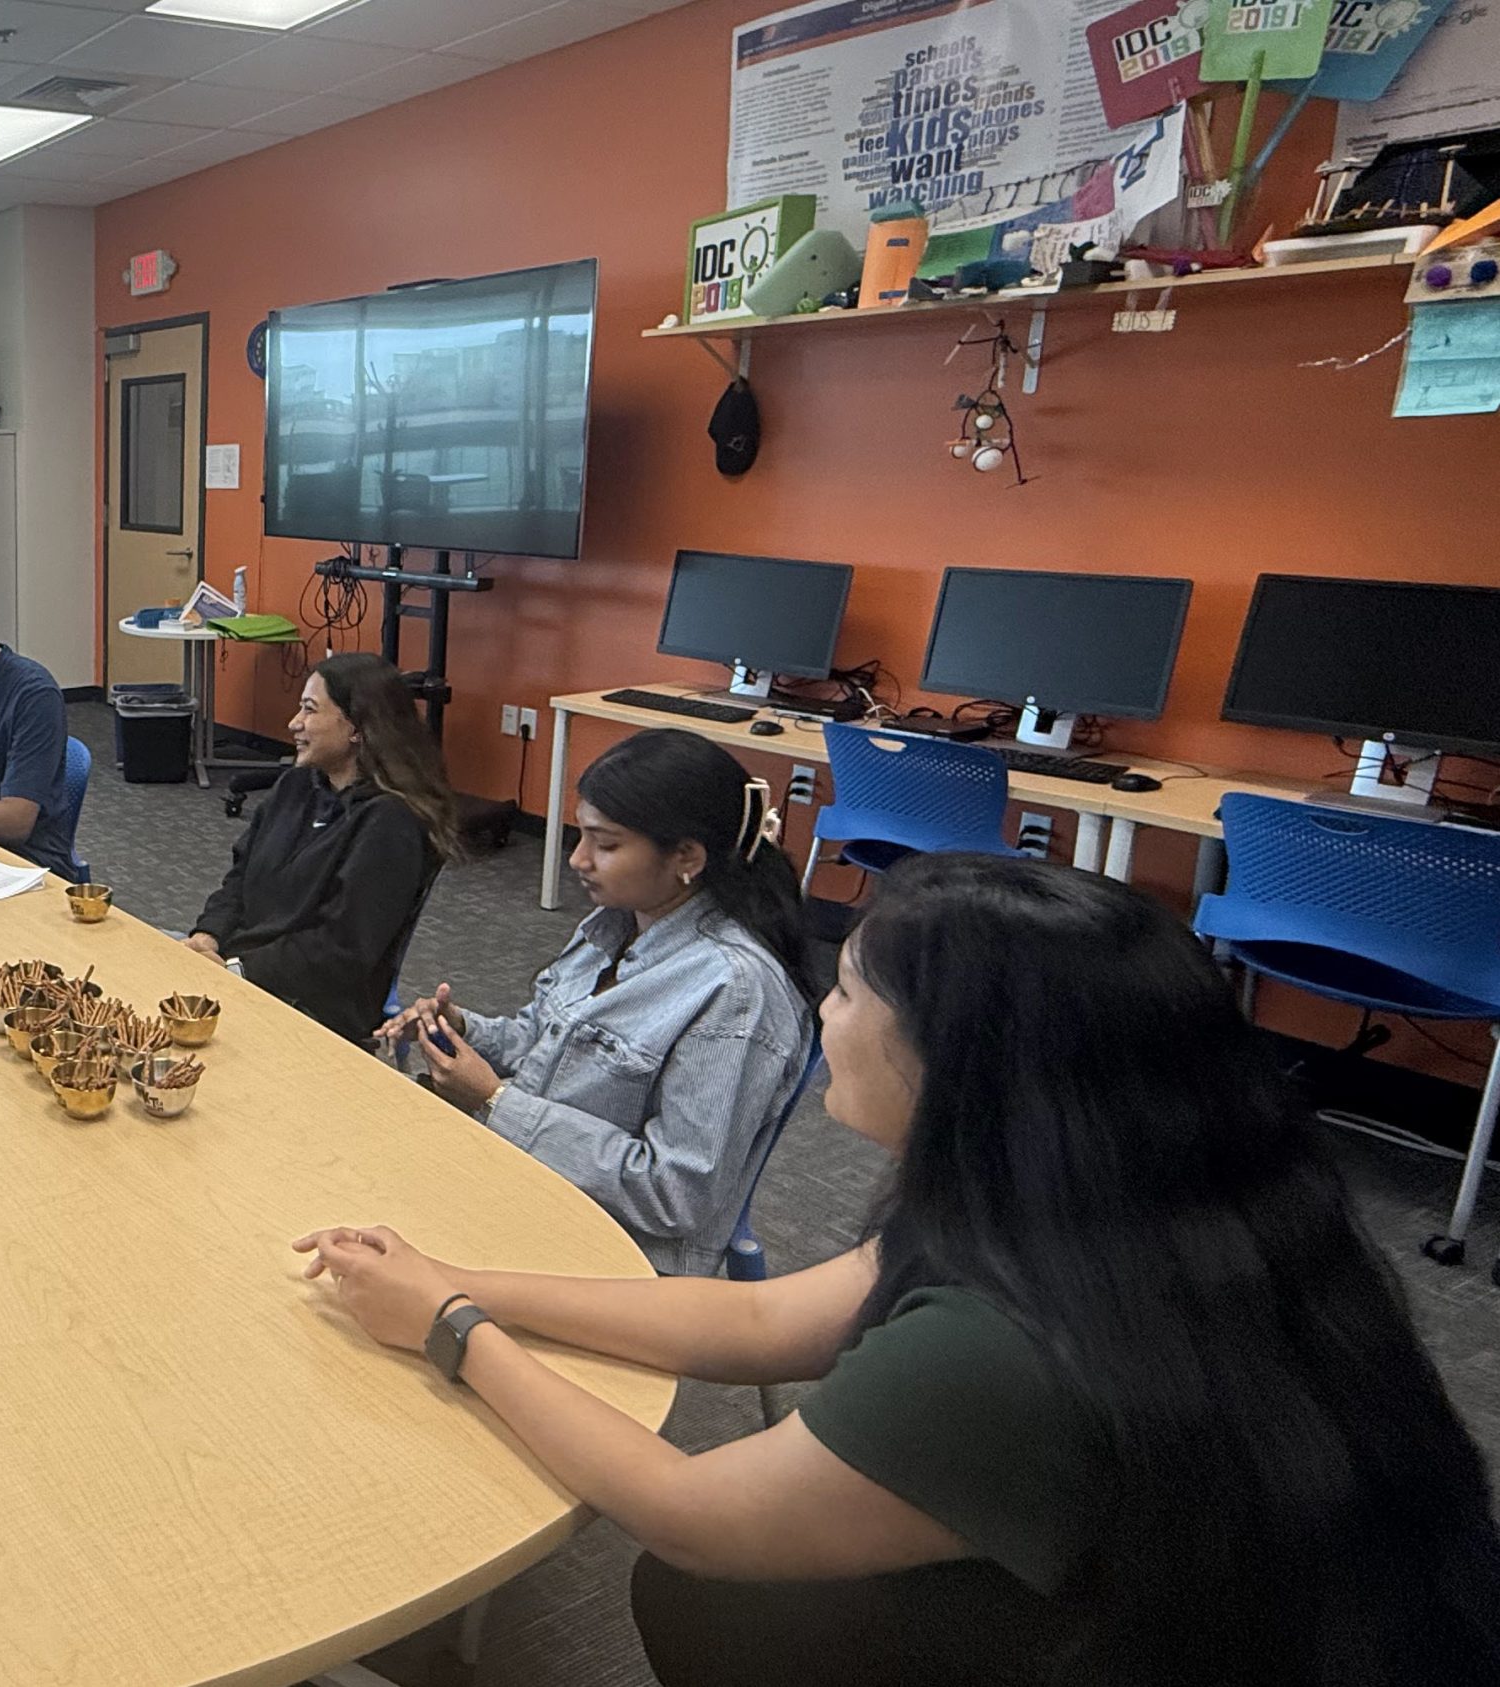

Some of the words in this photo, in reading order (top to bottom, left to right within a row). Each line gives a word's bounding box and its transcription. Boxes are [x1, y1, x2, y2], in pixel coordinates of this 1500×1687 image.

[1229, 5, 1288, 31] 2019
[905, 36, 976, 68] schools
[1115, 17, 1172, 61] IDC
[893, 48, 983, 90] parents
[892, 76, 978, 118] times
[887, 107, 972, 157] kids
[967, 125, 1020, 150] plays
[891, 144, 964, 184] want
[868, 171, 984, 210] watching
[1189, 186, 1211, 198] IDC
[693, 239, 736, 284] IDC
